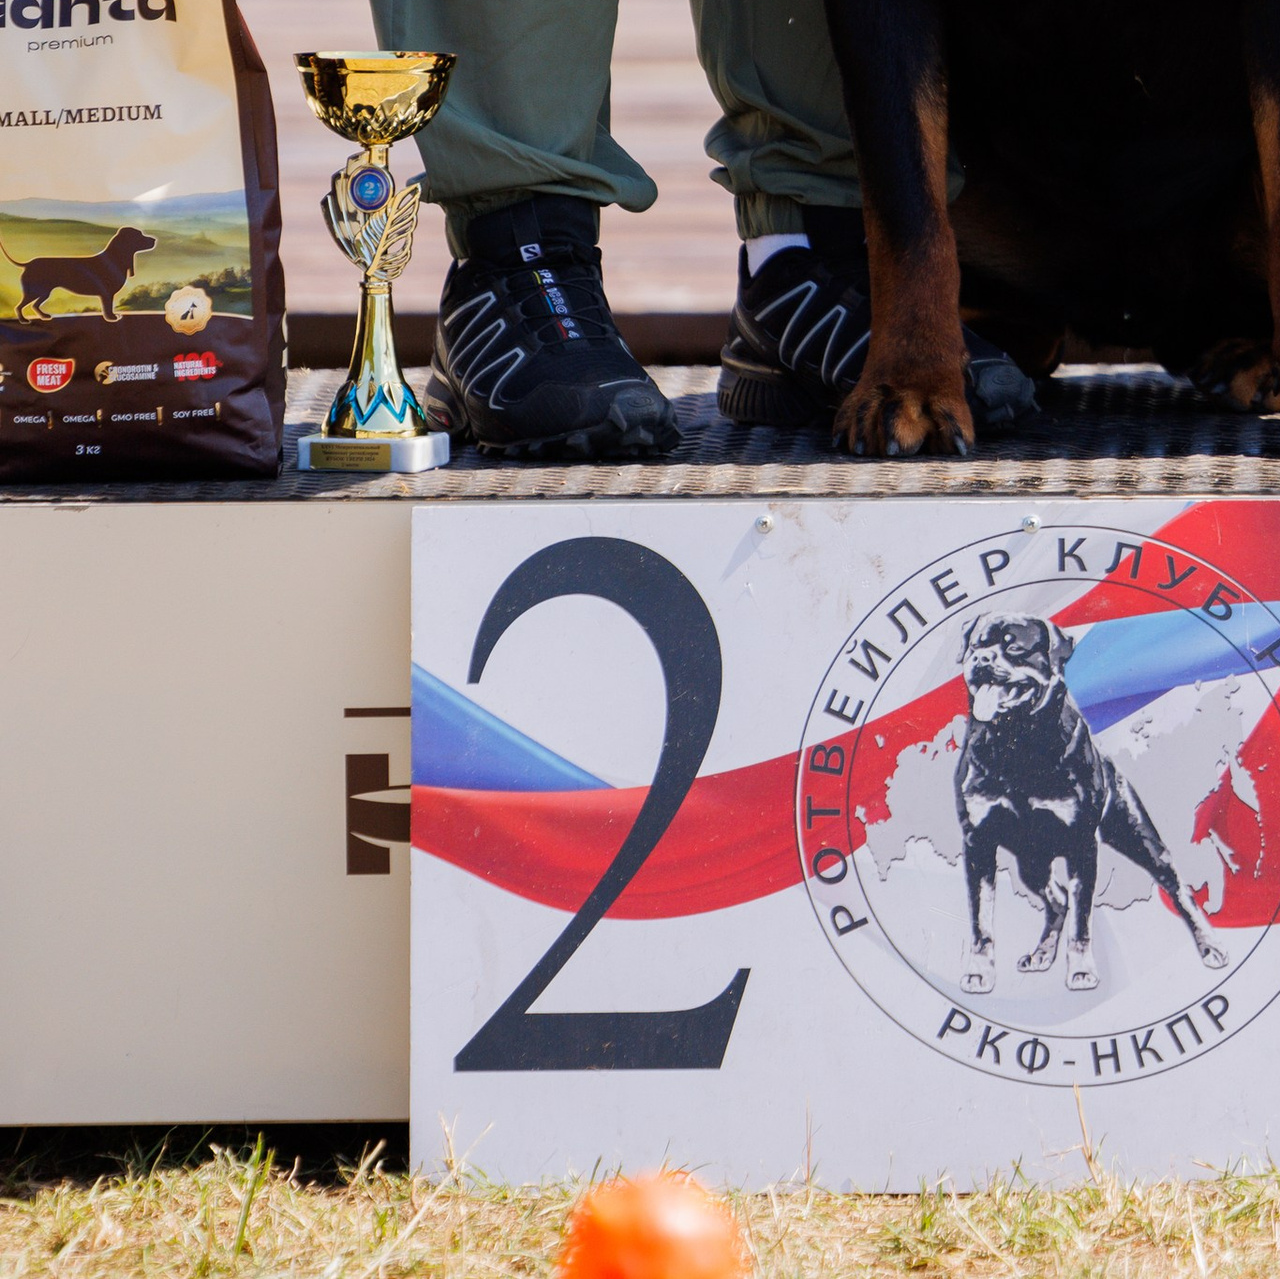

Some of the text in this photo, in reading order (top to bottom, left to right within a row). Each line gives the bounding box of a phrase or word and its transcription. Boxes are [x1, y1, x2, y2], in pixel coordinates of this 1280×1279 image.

[27, 33, 113, 53] premium
[0, 104, 163, 129] MALL/MEDIUM
[36, 364, 67, 374] FRESH
[173, 360, 203, 370] NATURAL
[174, 366, 217, 378] INGREDIENTS
[37, 375, 62, 386] MEAT
[62, 415, 96, 423] OMEGA
[111, 412, 157, 422] GMO FREE
[172, 408, 215, 419] SOY FREE
[13, 415, 46, 424] OMEGA
[75, 444, 85, 455] 3
[806, 548, 1010, 938] РОТВЕЙЛЕР
[1056, 537, 1240, 622] КЛУБ
[453, 536, 750, 1071] 2
[937, 993, 1230, 1078] РКФ-НКПР
